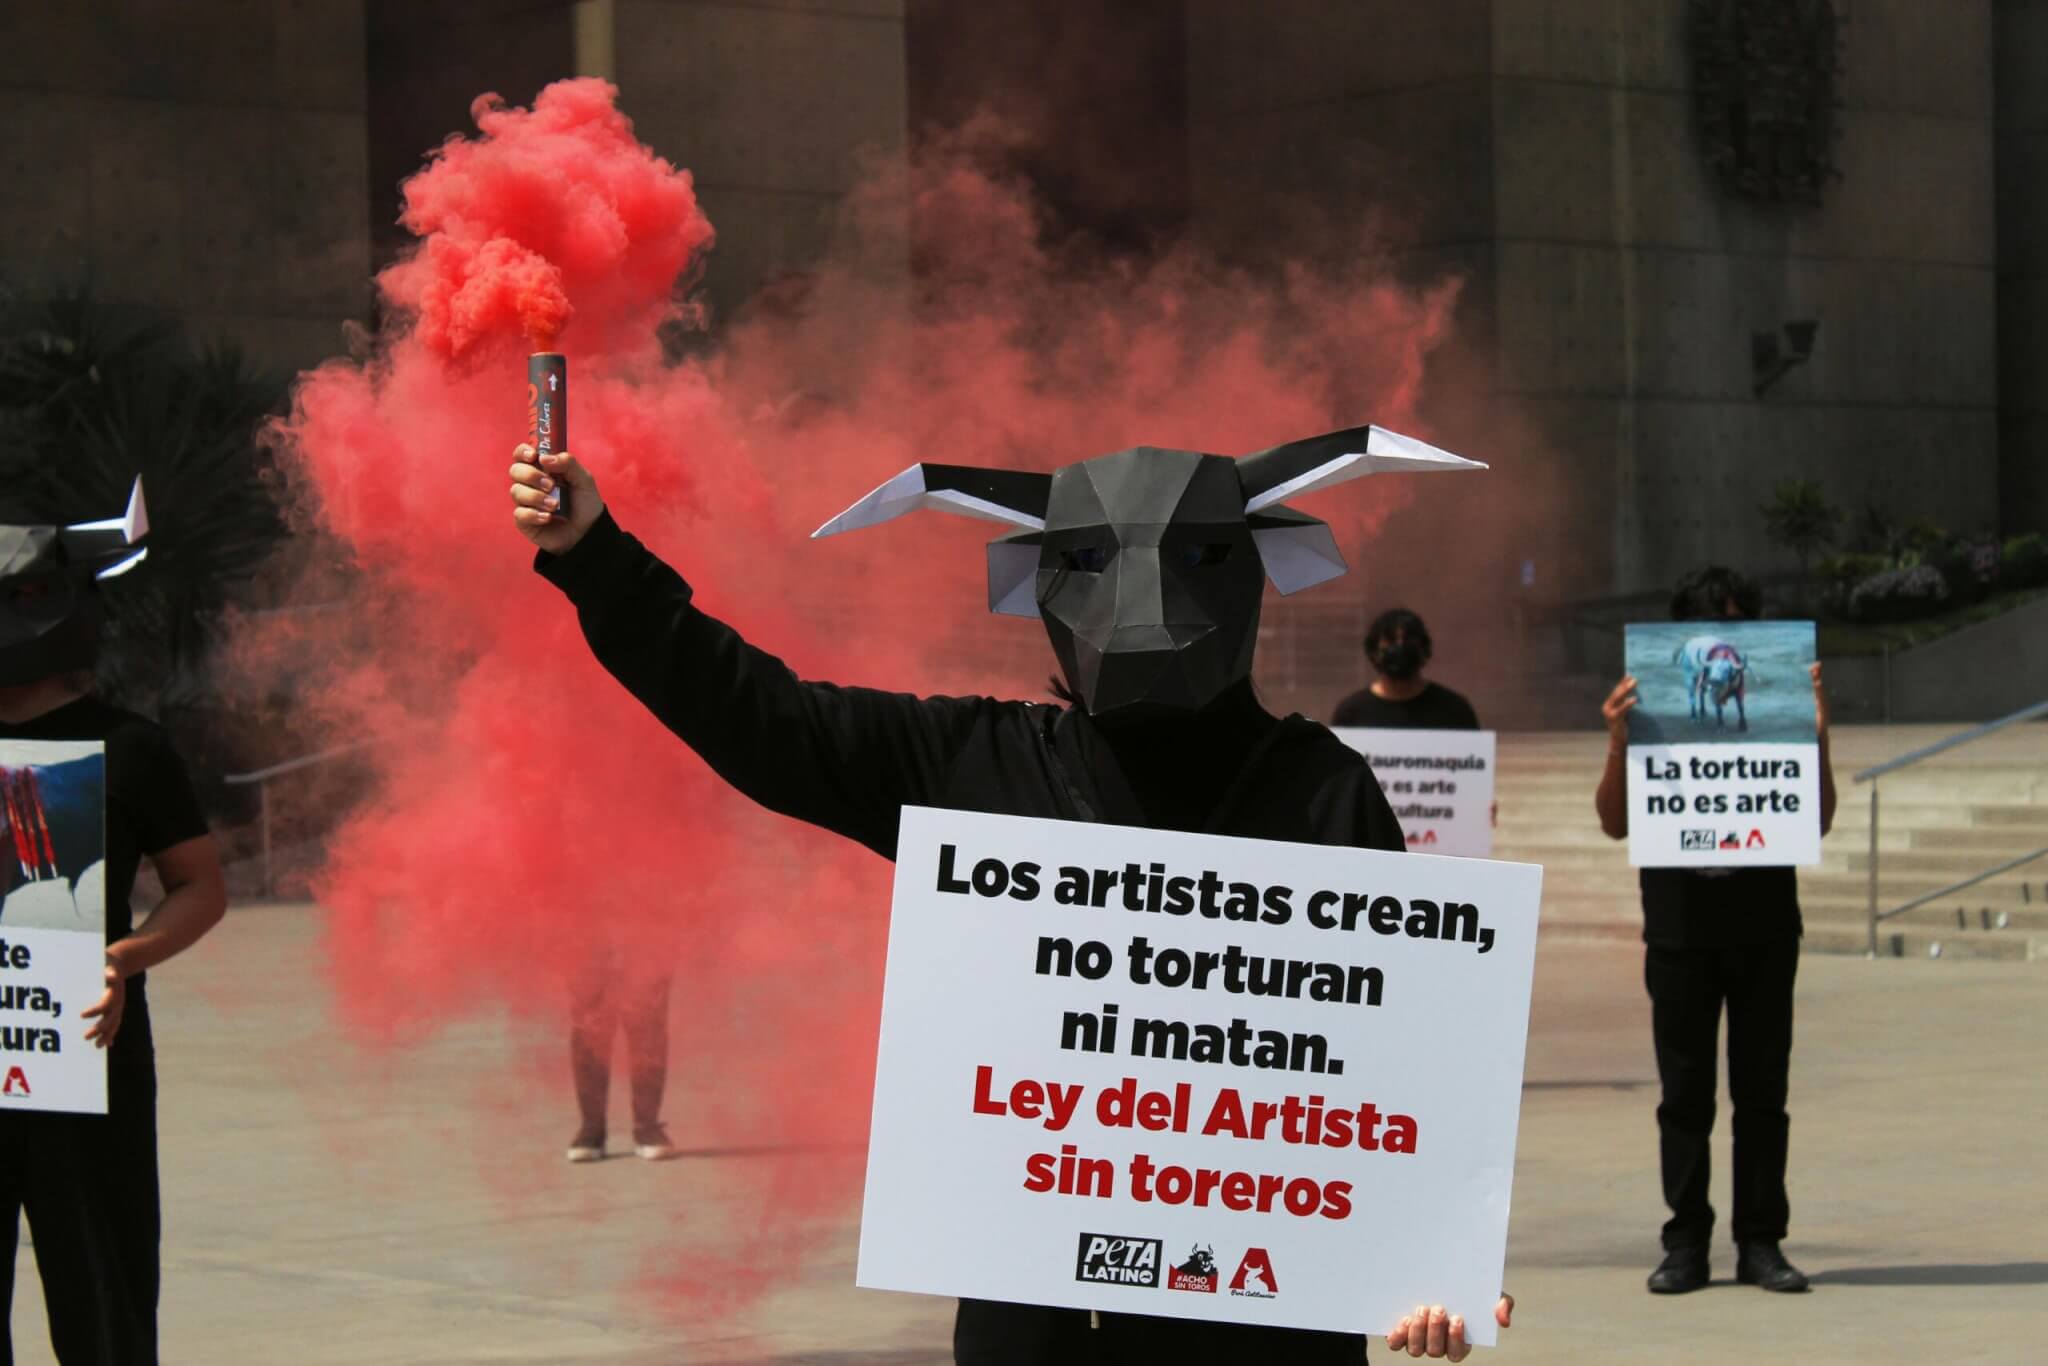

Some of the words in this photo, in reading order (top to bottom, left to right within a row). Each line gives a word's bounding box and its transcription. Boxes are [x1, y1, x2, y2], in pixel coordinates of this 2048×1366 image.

[1393, 781, 1413, 794] es
[1418, 780, 1456, 794] arte
[1644, 756, 1681, 780] La
[1689, 756, 1800, 780] tortura
[1646, 794, 1686, 814] no
[1694, 794, 1728, 814] es
[1736, 790, 1800, 814] arte
[936, 843, 1042, 902] Los
[1054, 862, 1294, 924] artistas
[1306, 890, 1496, 954] crean,
[1035, 936, 1113, 981] no
[1127, 936, 1384, 1007] torturan
[1060, 1003, 1119, 1054] ni
[1130, 1018, 1345, 1075] matan.
[973, 1065, 1085, 1132] Ley
[1096, 1077, 1192, 1133] del
[1201, 1088, 1418, 1155] Artista
[1023, 1144, 1114, 1199] sin
[1129, 1154, 1353, 1220] toreros
[1081, 1263, 1154, 1284] LATINO
[1188, 1283, 1210, 1291] TOROS
